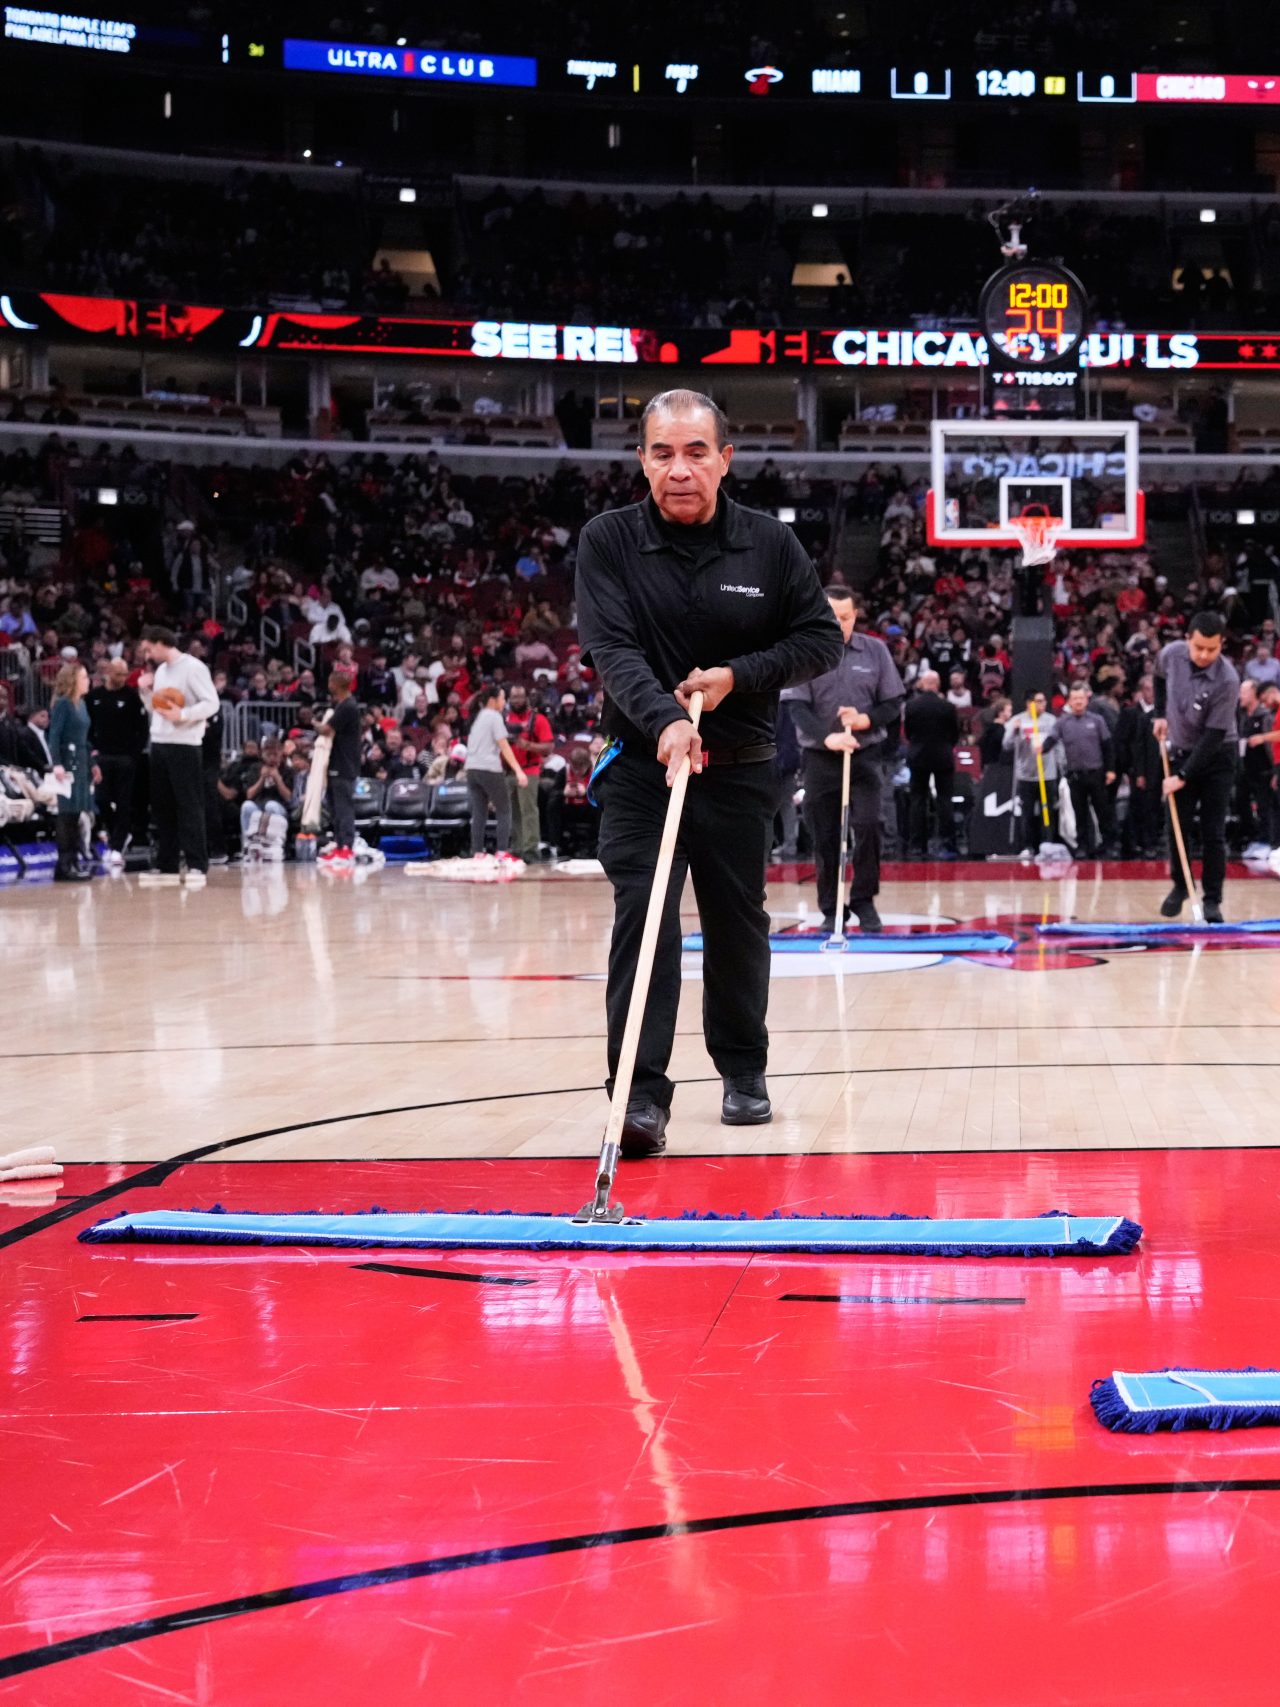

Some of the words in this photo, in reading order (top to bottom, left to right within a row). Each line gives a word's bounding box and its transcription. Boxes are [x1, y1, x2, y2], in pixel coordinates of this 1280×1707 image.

[327, 48, 398, 71] ULTRA
[420, 55, 494, 78] CLUB
[914, 71, 929, 95] 0
[975, 70, 1036, 96] 12:00
[1099, 75, 1115, 98] 0
[1156, 76, 1226, 100] CHICAGO
[1009, 283, 1068, 309] 12:00
[471, 321, 557, 359] SEE
[1005, 308, 1063, 353] 24
[1014, 371, 1078, 386] TISSOT
